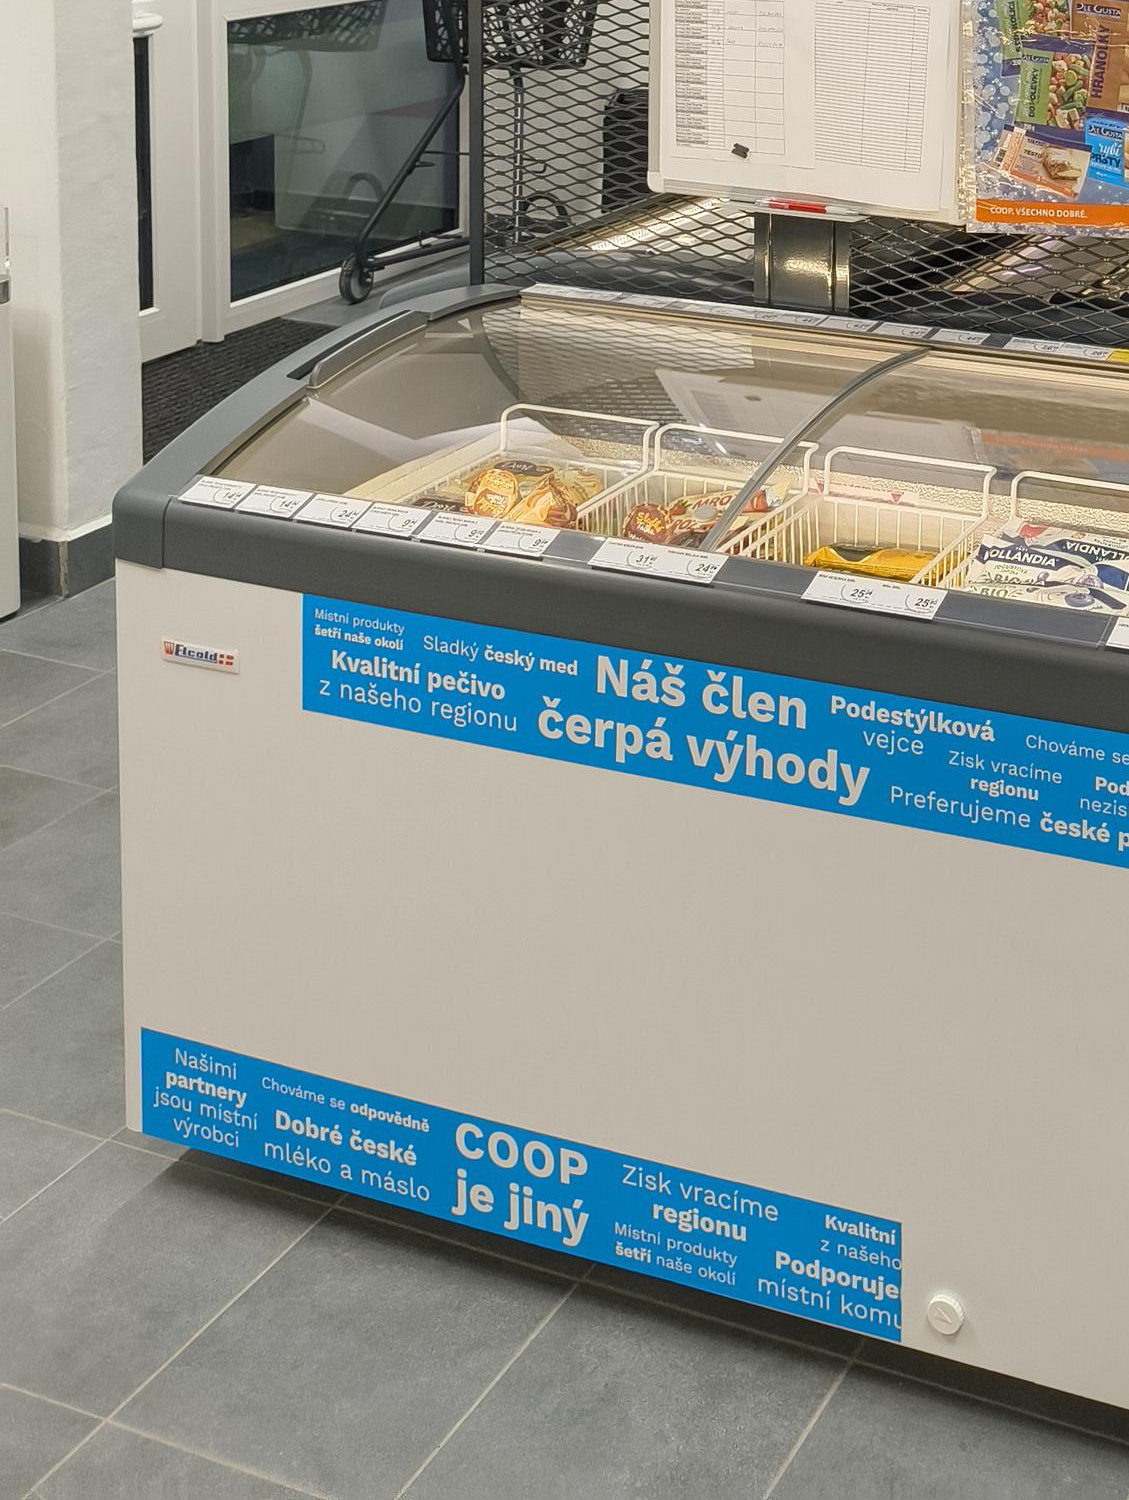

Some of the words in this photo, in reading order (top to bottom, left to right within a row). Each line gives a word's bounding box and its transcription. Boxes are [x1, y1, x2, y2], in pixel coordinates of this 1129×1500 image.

[1090, 24, 1112, 99] HRANOLKY
[990, 205, 1015, 217] COOP.
[1015, 206, 1055, 218] VŠECHNO
[1056, 208, 1088, 219] DOBRÉ.
[314, 607, 349, 626] Místní
[352, 615, 405, 636] produkty
[314, 625, 342, 641] šetří
[344, 631, 372, 646] naše
[374, 635, 404, 651] okolí
[331, 649, 421, 684] Kvalitní
[427, 666, 507, 700] pečivo
[423, 635, 480, 662] Sladký
[484, 643, 536, 672] český
[539, 656, 578, 676] med
[319, 679, 331, 697] z
[340, 680, 422, 714] našeho
[430, 699, 518, 733] regionu
[596, 654, 687, 707] Náš
[701, 669, 808, 730] člen
[830, 694, 996, 742] Podestýlková
[538, 696, 674, 764] čerpá
[686, 728, 871, 807] výhody
[863, 729, 925, 756] vejce
[1025, 734, 1106, 762] Chováme
[948, 750, 986, 771] Zisk
[990, 759, 1063, 784] vracíme
[969, 777, 1039, 802] regionu
[890, 784, 1031, 830] Preferujeme
[1039, 810, 1111, 844] české
[174, 1047, 238, 1080] Našimi
[153, 1085, 193, 1113] jsou
[199, 1100, 259, 1131] místní
[165, 1070, 248, 1108] partnery
[261, 1076, 326, 1105] Chováme
[329, 1096, 346, 1111] se
[350, 1101, 430, 1133] odpovědně
[173, 1117, 240, 1148] výrobci
[275, 1109, 343, 1147] Dobré
[349, 1129, 417, 1167] české
[455, 1122, 589, 1186] COOP
[263, 1139, 332, 1174] mléko
[340, 1161, 353, 1181] a
[361, 1164, 430, 1202] máslo
[622, 1163, 672, 1196] Zisk
[679, 1183, 780, 1222] vracíme
[451, 1168, 495, 1217] je
[503, 1182, 590, 1248] jiný
[652, 1203, 748, 1242] regionu
[825, 1214, 897, 1246] Kvalitní
[614, 1221, 661, 1247] Místní
[666, 1235, 738, 1268] produkty
[614, 1242, 652, 1264] šetří
[656, 1253, 693, 1275] naše
[697, 1264, 737, 1287] okolí
[820, 1238, 830, 1253] z
[836, 1243, 903, 1272] našeho
[758, 1276, 831, 1311] místní
[775, 1251, 900, 1301] Podporuje
